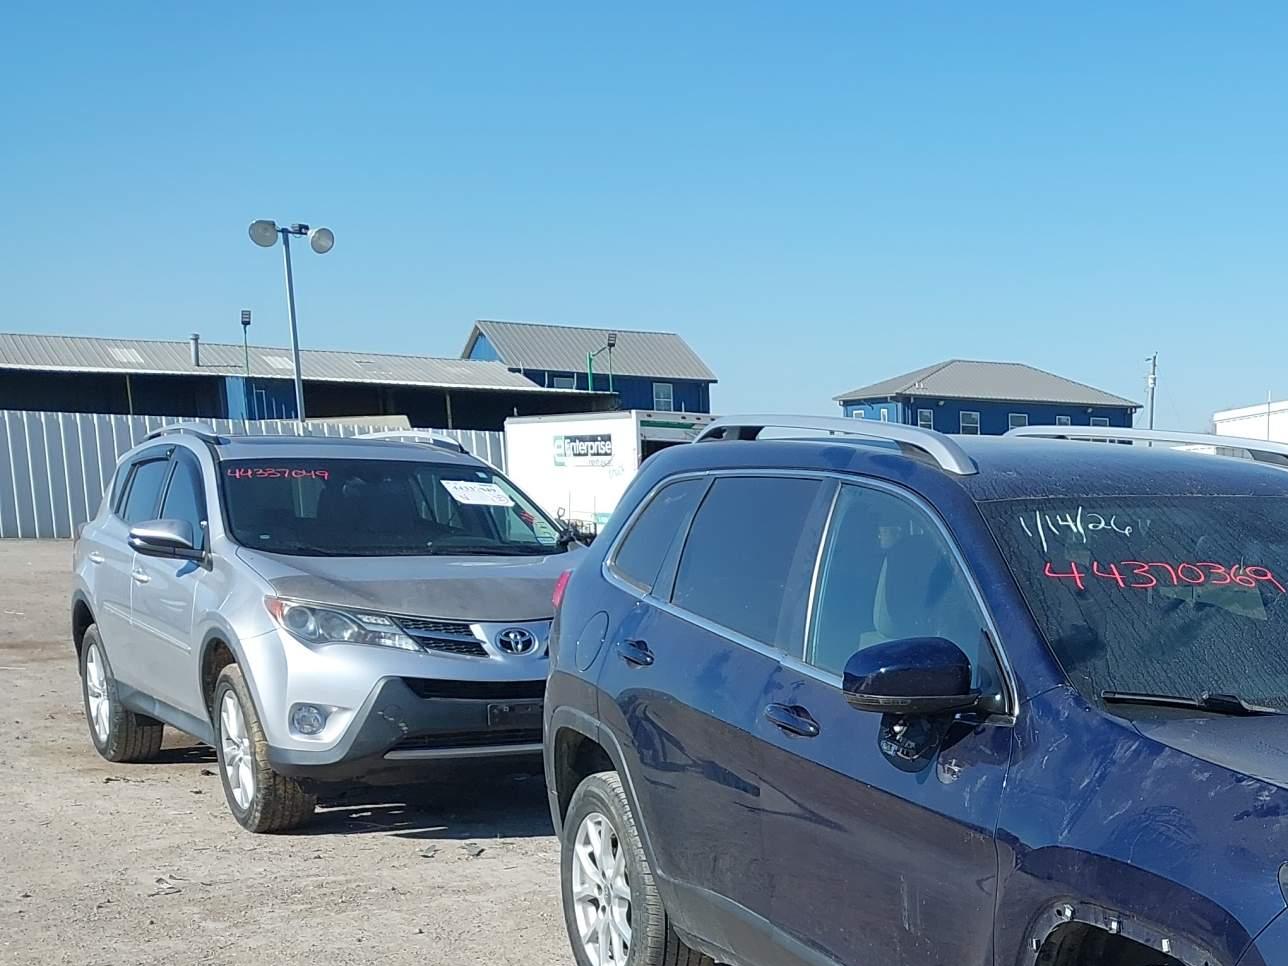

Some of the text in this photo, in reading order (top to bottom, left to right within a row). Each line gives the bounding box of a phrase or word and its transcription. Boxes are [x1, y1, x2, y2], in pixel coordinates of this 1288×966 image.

[564, 435, 612, 457] Enterprise
[1019, 506, 1133, 552] 1/14/26
[1043, 561, 1287, 593] 44370369
